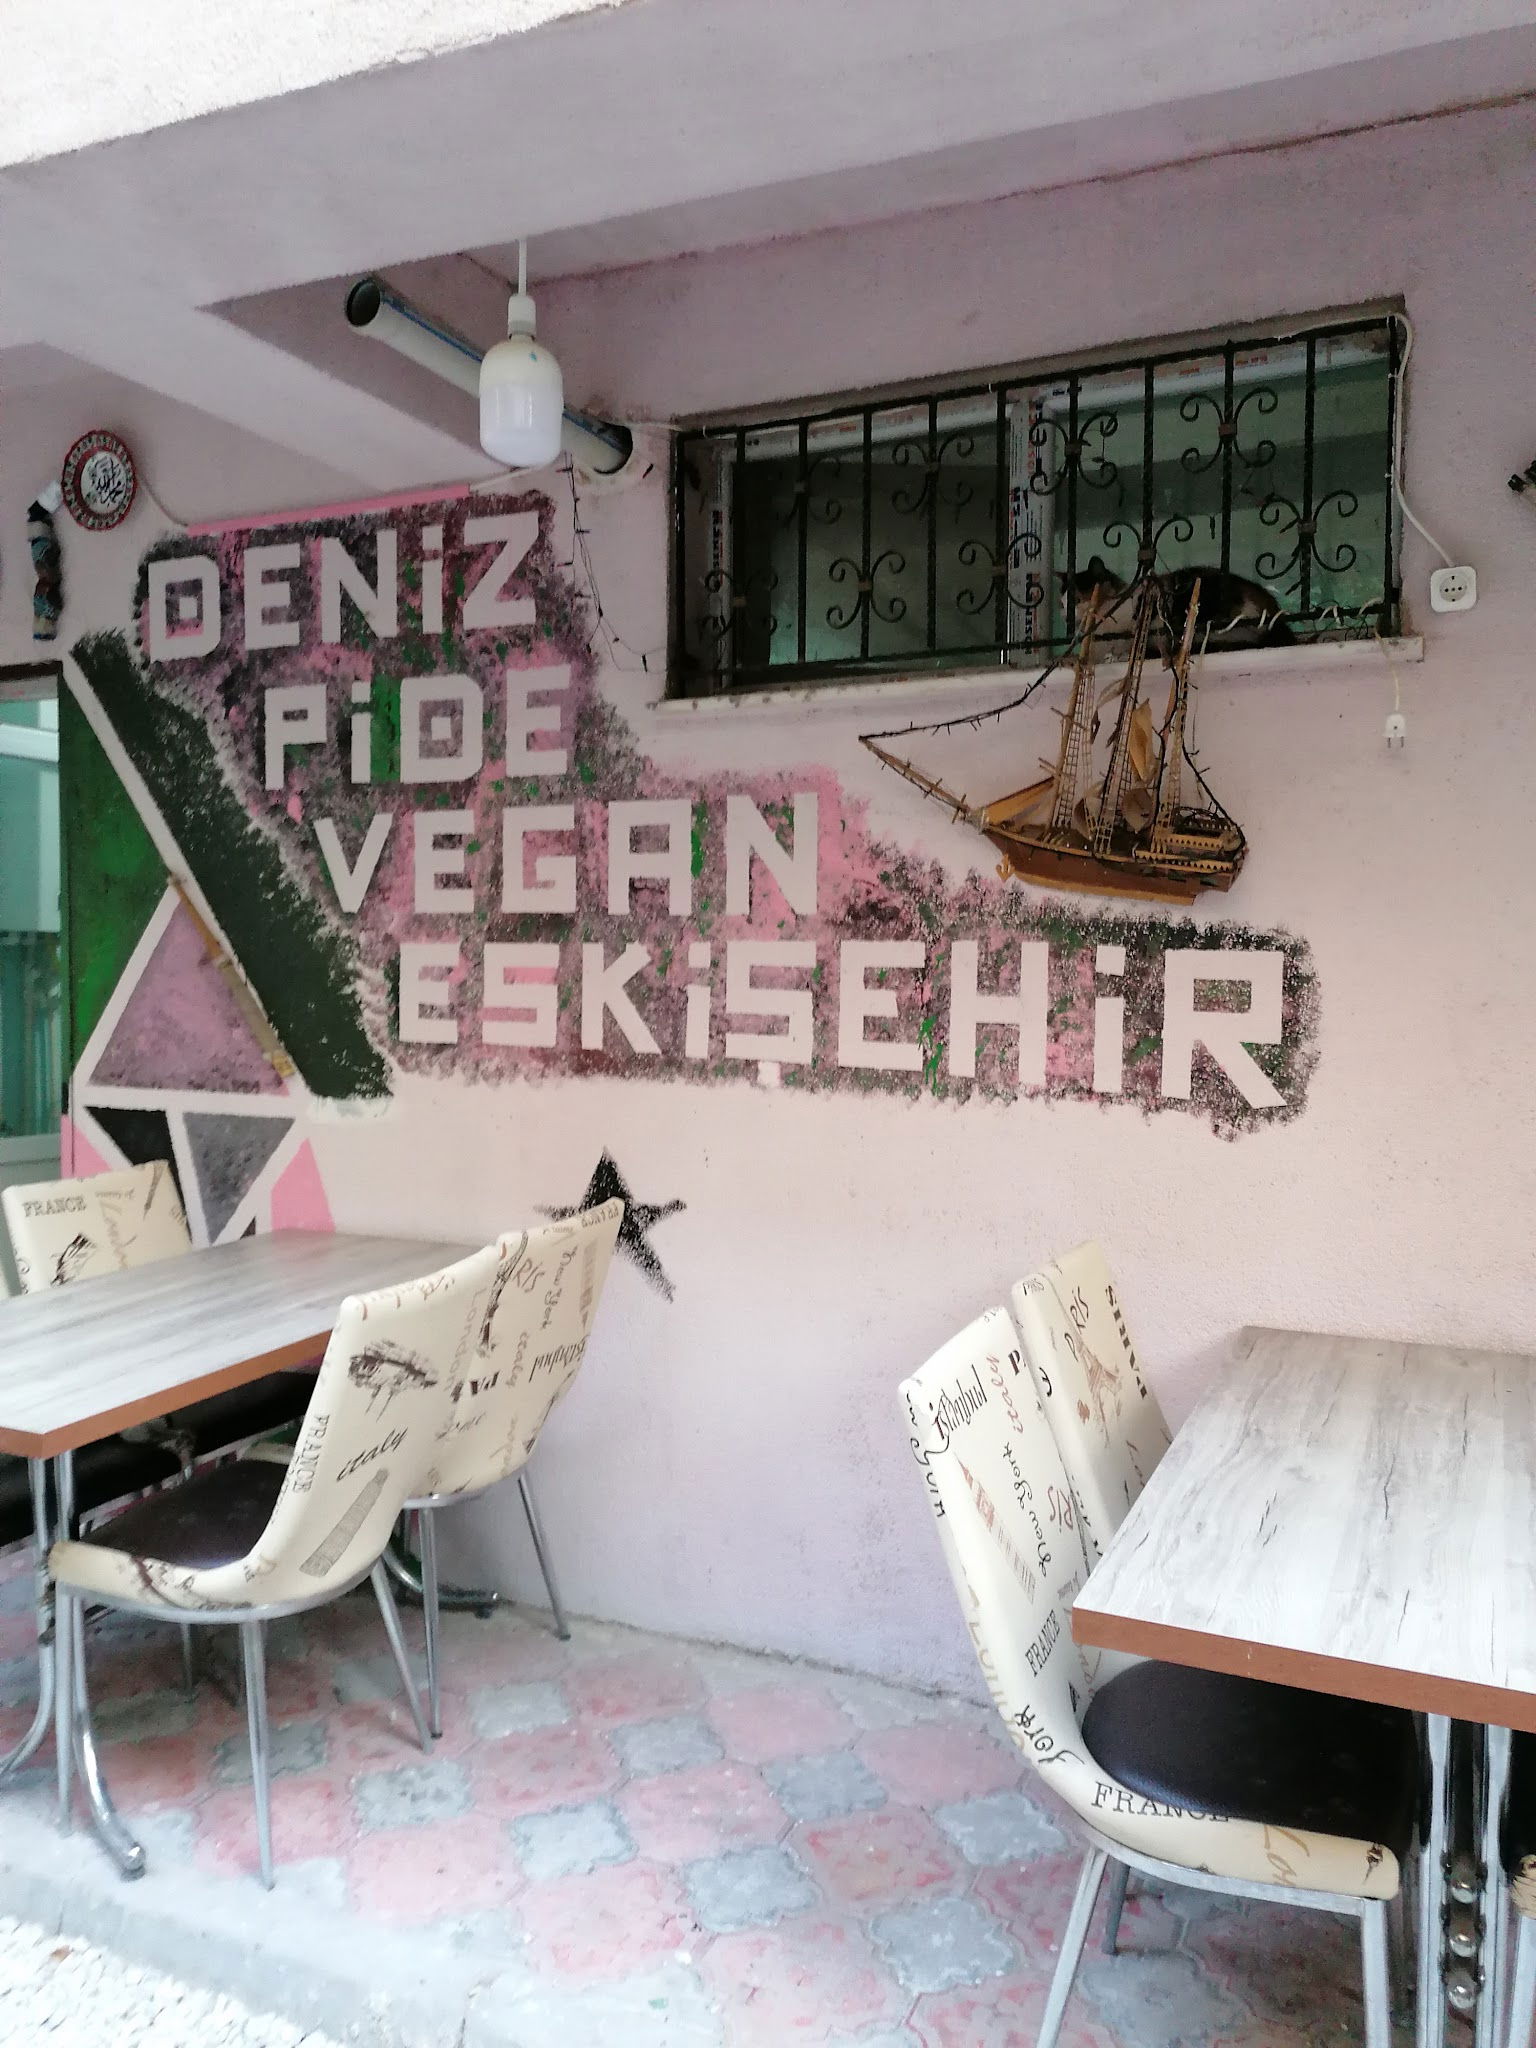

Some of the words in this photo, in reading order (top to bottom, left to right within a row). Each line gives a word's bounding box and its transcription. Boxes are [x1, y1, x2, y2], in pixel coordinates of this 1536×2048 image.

[315, 792, 818, 916] VEGAN
[22, 1195, 88, 1218] FRANCE
[293, 1414, 331, 1493] FRANCE
[1025, 1610, 1060, 1677] FRANCE
